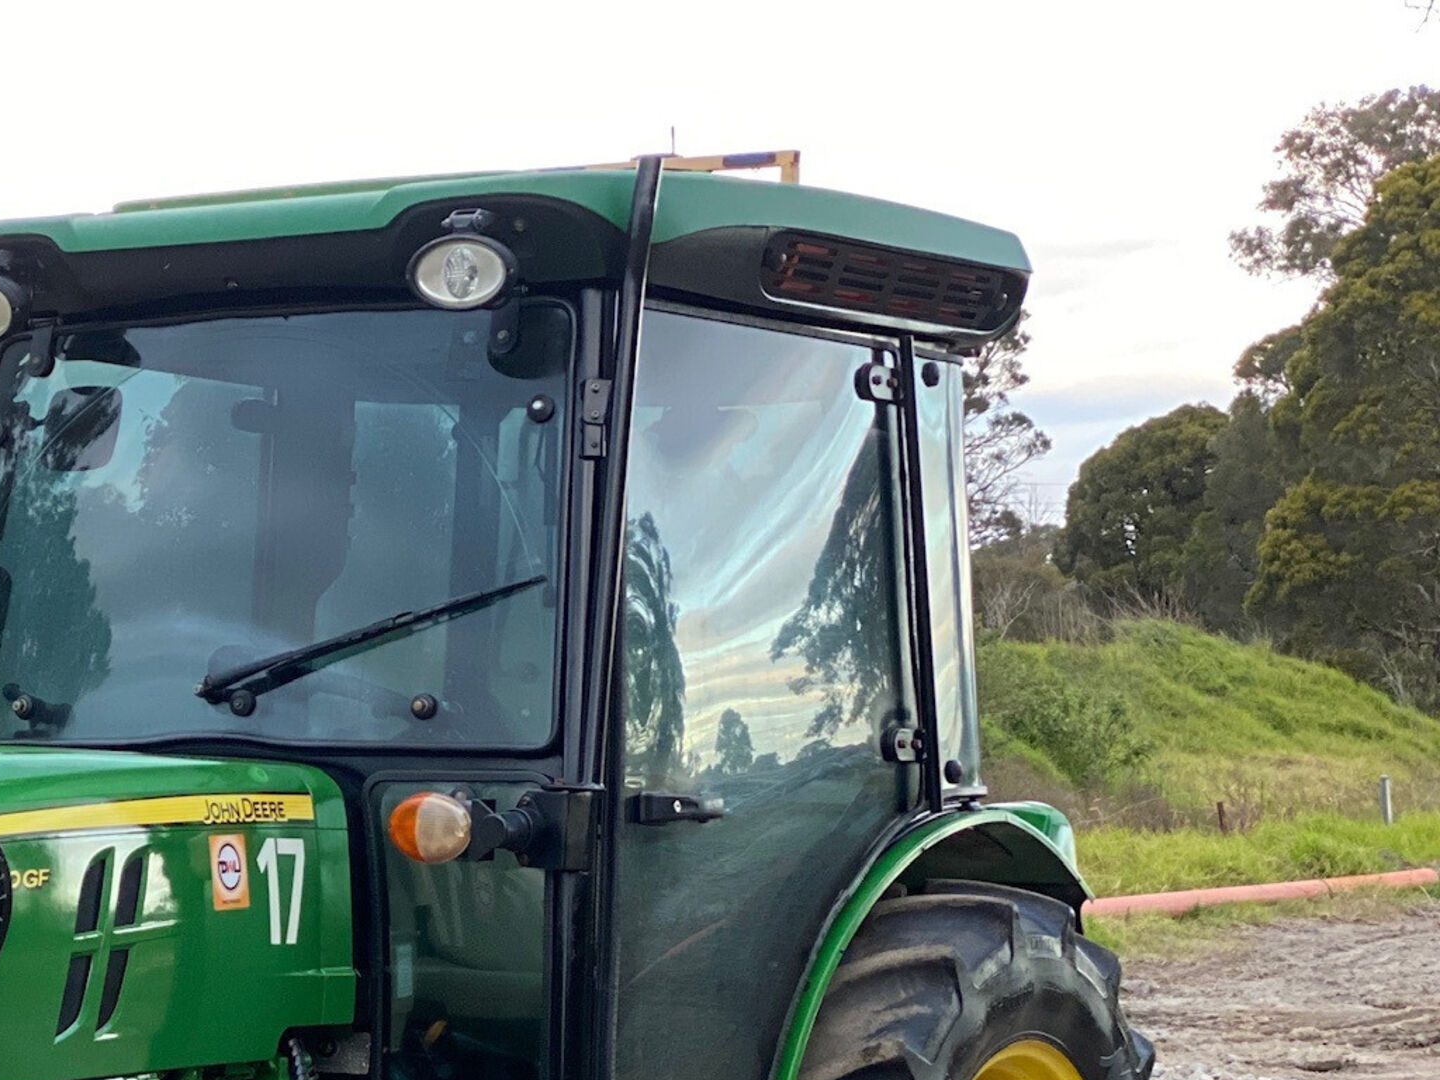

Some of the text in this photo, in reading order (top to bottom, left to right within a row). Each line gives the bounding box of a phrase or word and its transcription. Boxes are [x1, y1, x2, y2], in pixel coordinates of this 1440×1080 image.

[204, 797, 287, 822] JOHN DEERE
[257, 838, 305, 945] 17
